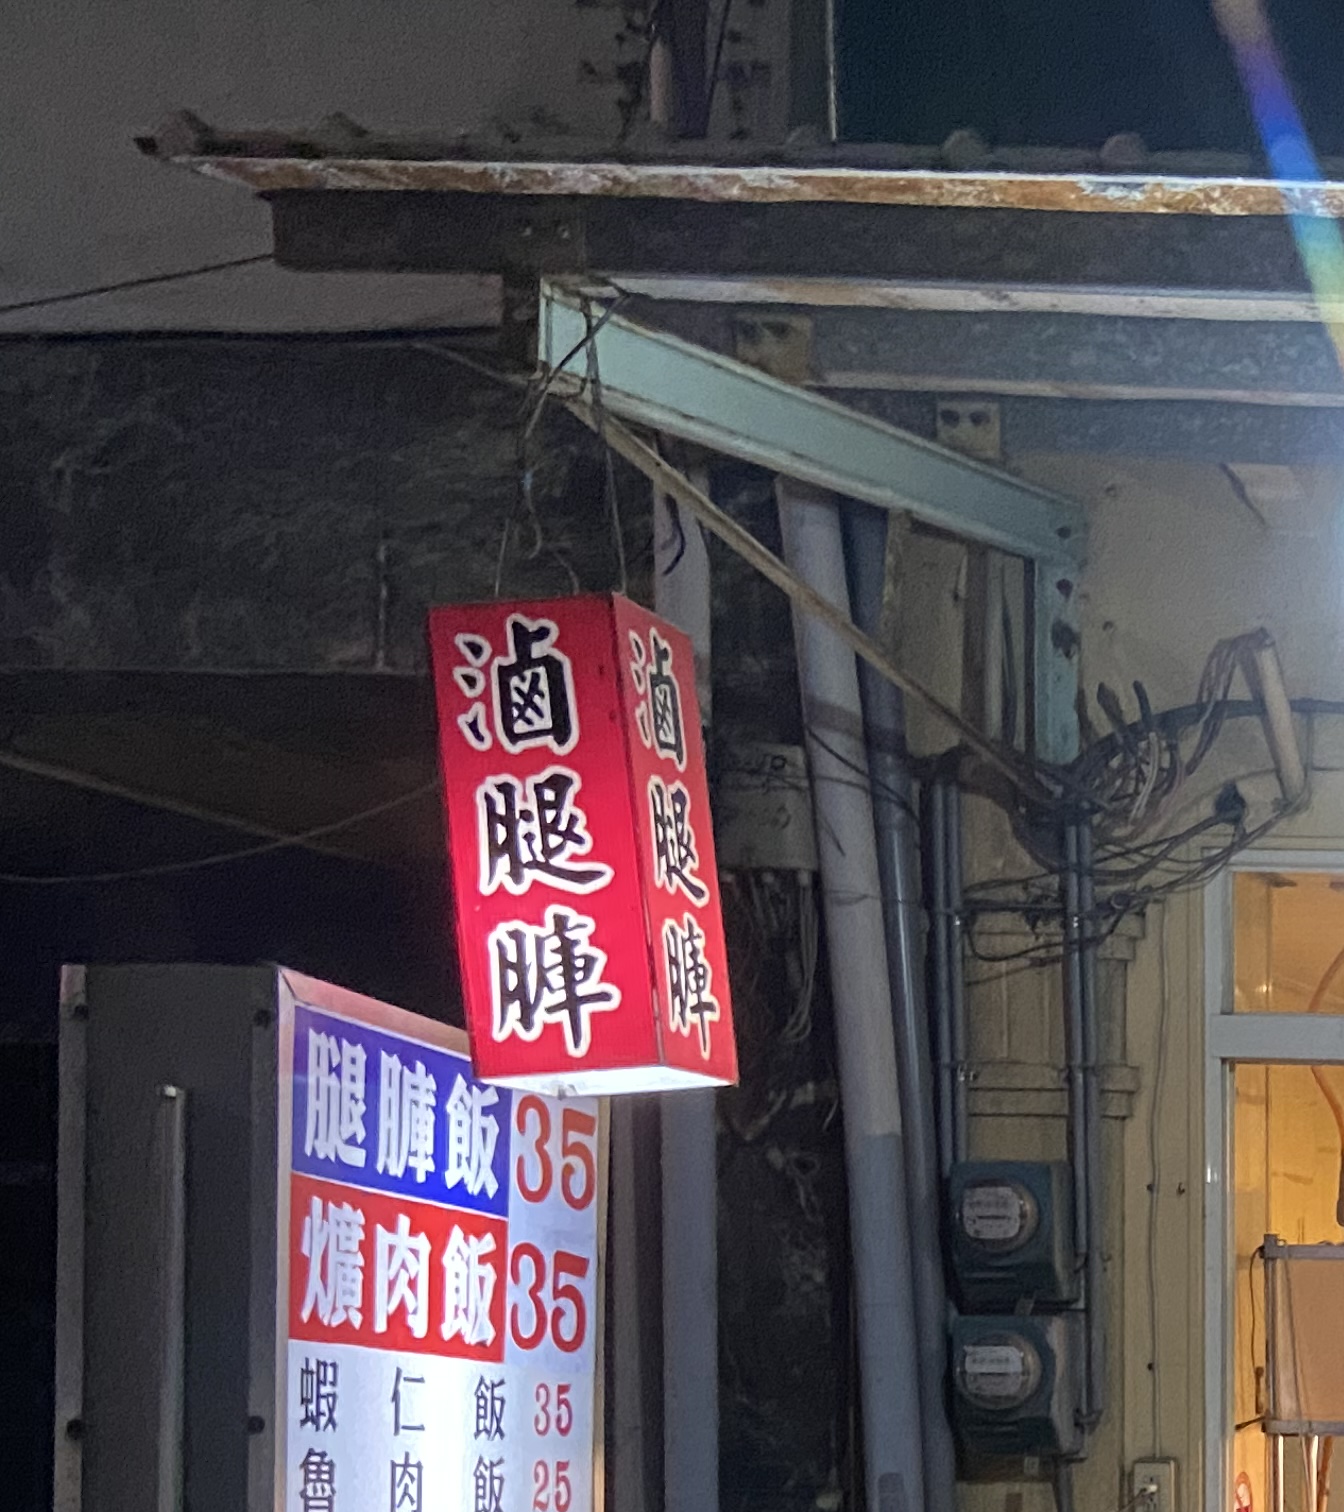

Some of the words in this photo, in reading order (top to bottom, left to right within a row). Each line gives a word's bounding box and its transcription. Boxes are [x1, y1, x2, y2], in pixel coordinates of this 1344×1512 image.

[516, 1095, 597, 1210] 35
[510, 1243, 590, 1353] 35
[300, 1357, 506, 1442] 蝦仁飯
[534, 1383, 573, 1437] 35
[532, 1459, 572, 1512] 25
